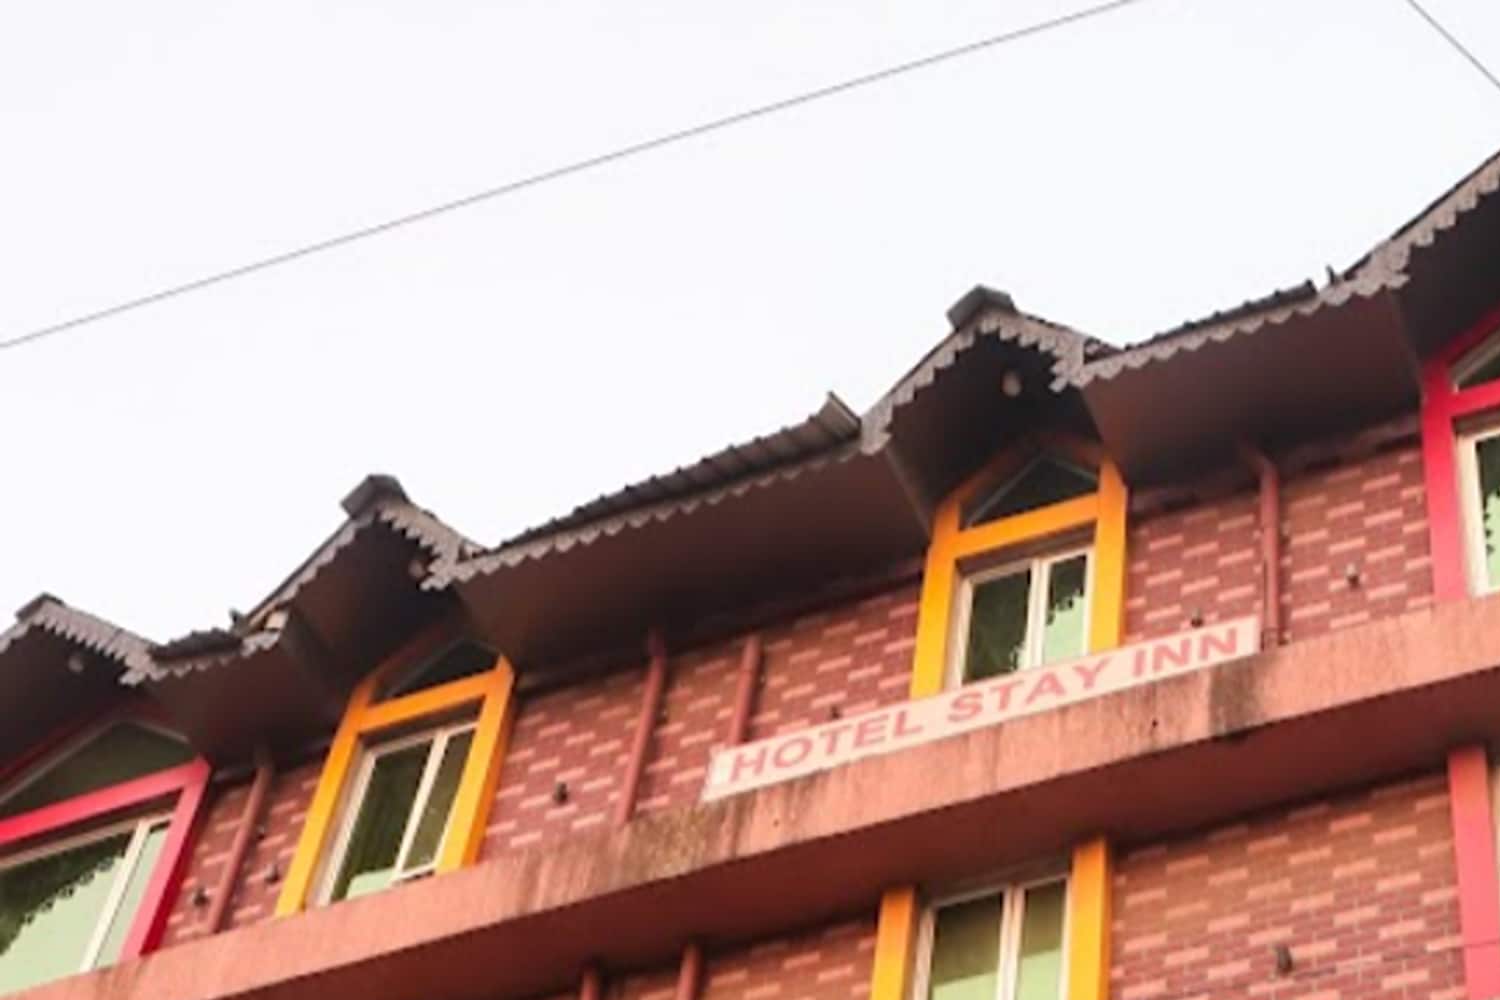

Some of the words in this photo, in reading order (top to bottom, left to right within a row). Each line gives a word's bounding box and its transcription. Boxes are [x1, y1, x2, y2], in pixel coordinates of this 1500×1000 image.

[728, 708, 923, 784] HOTEL
[946, 655, 1112, 724] STAY
[1132, 627, 1240, 677] INN
